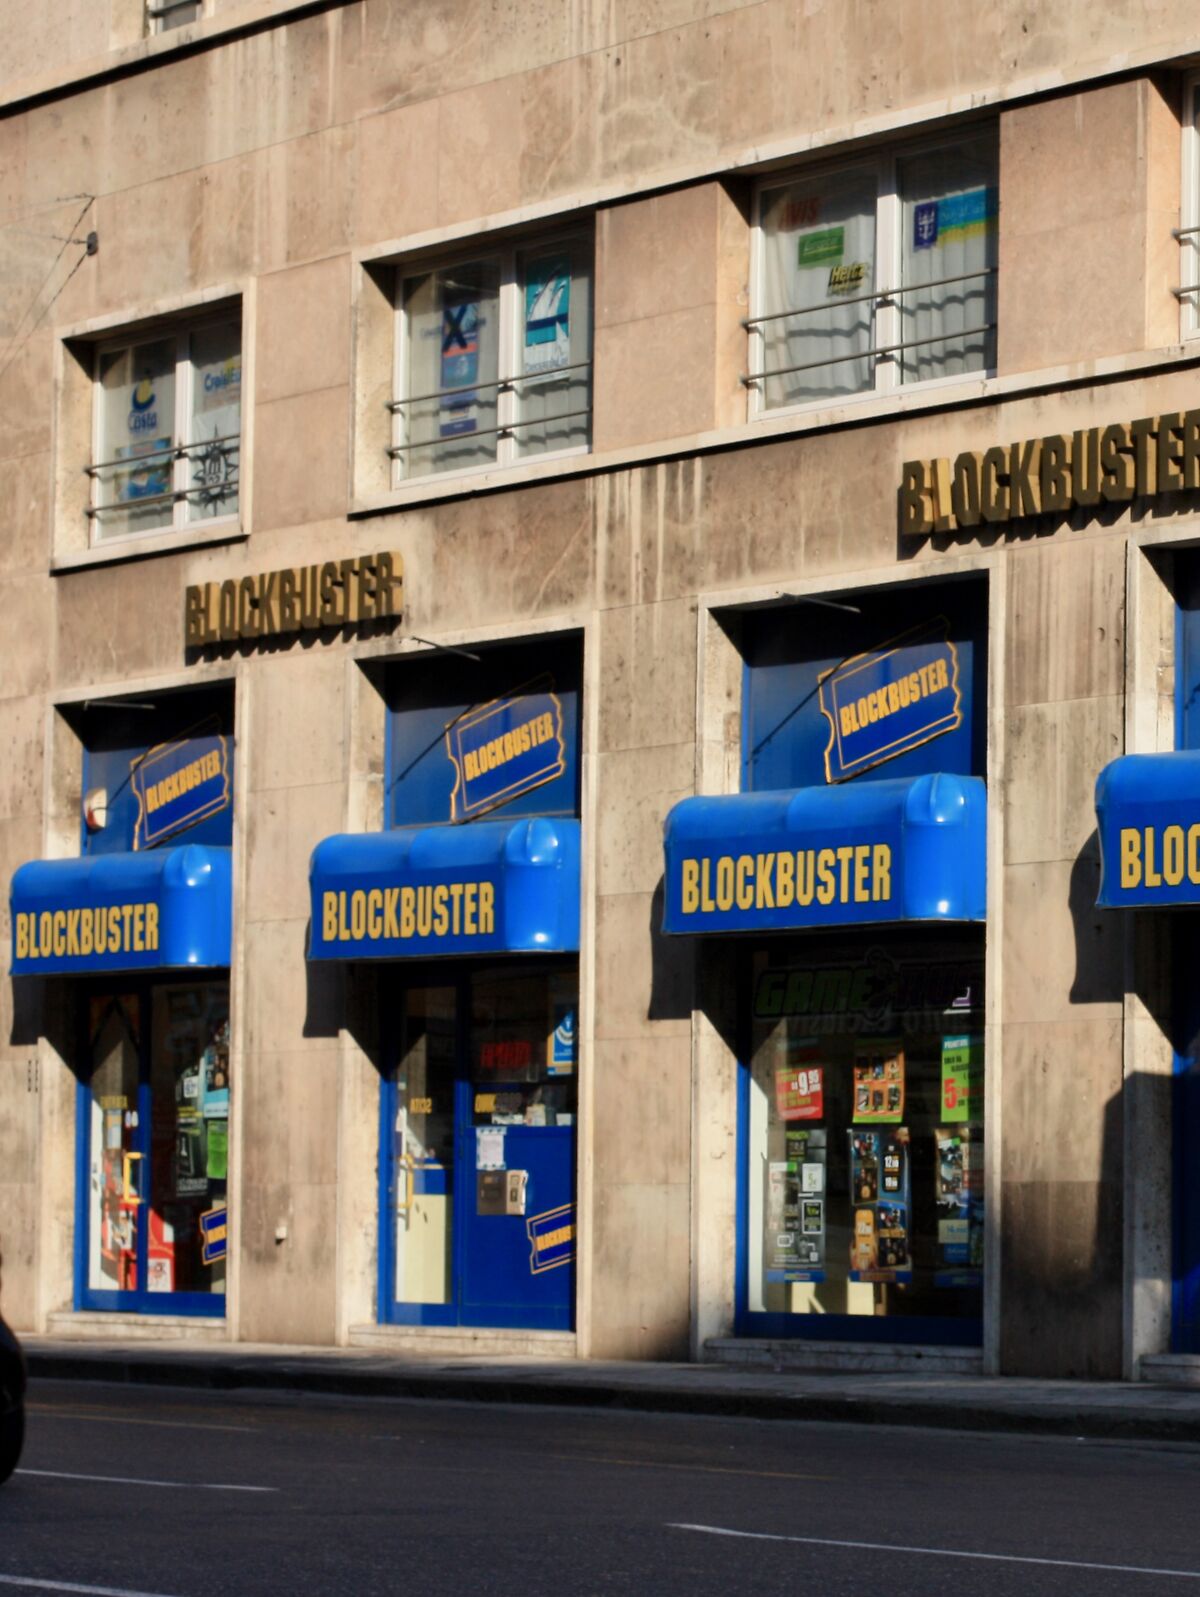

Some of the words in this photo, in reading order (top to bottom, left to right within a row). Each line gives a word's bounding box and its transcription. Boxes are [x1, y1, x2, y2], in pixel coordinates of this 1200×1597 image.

[185, 551, 403, 648] BLOCKBUSTER
[839, 658, 949, 737] BLOCKBUSTER
[463, 711, 554, 783] BLOCKBUSTER
[145, 748, 221, 812] BLOCKBUSTER
[682, 843, 891, 914] BLOCKBUSTER
[15, 902, 159, 959] BLOCKBUSTER
[322, 881, 494, 941] BLOCKBUSTER
[755, 966, 874, 1016] GAME
[944, 1077, 957, 1110] 5
